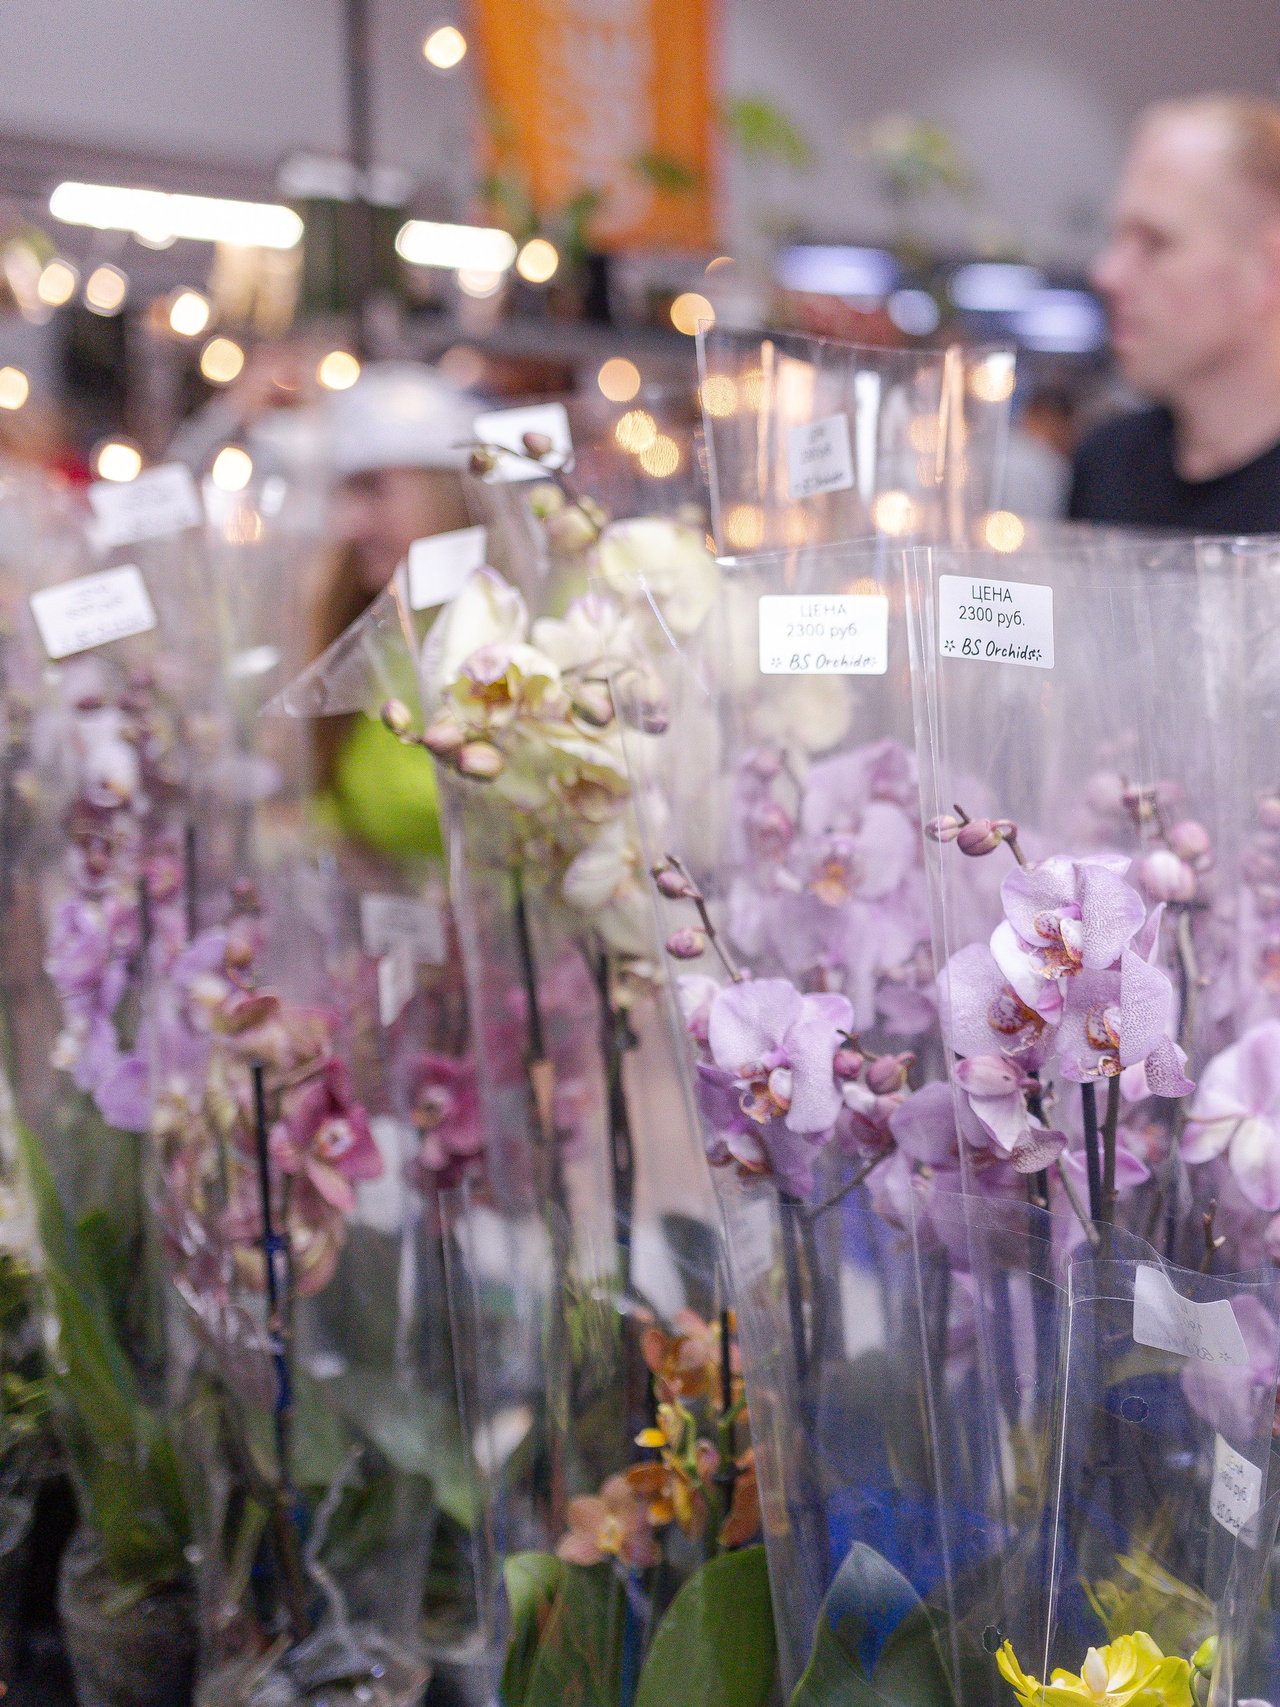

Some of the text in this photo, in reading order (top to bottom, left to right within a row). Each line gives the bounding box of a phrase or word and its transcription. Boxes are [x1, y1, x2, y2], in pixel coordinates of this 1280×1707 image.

[971, 585, 1013, 603] ЦЕНА
[800, 604, 847, 618] ЦЕНА
[958, 605, 1025, 629] 2300 руб.
[786, 623, 825, 637] 2300
[961, 637, 1034, 660] BS Orchids
[789, 653, 871, 670] BS Orchids
